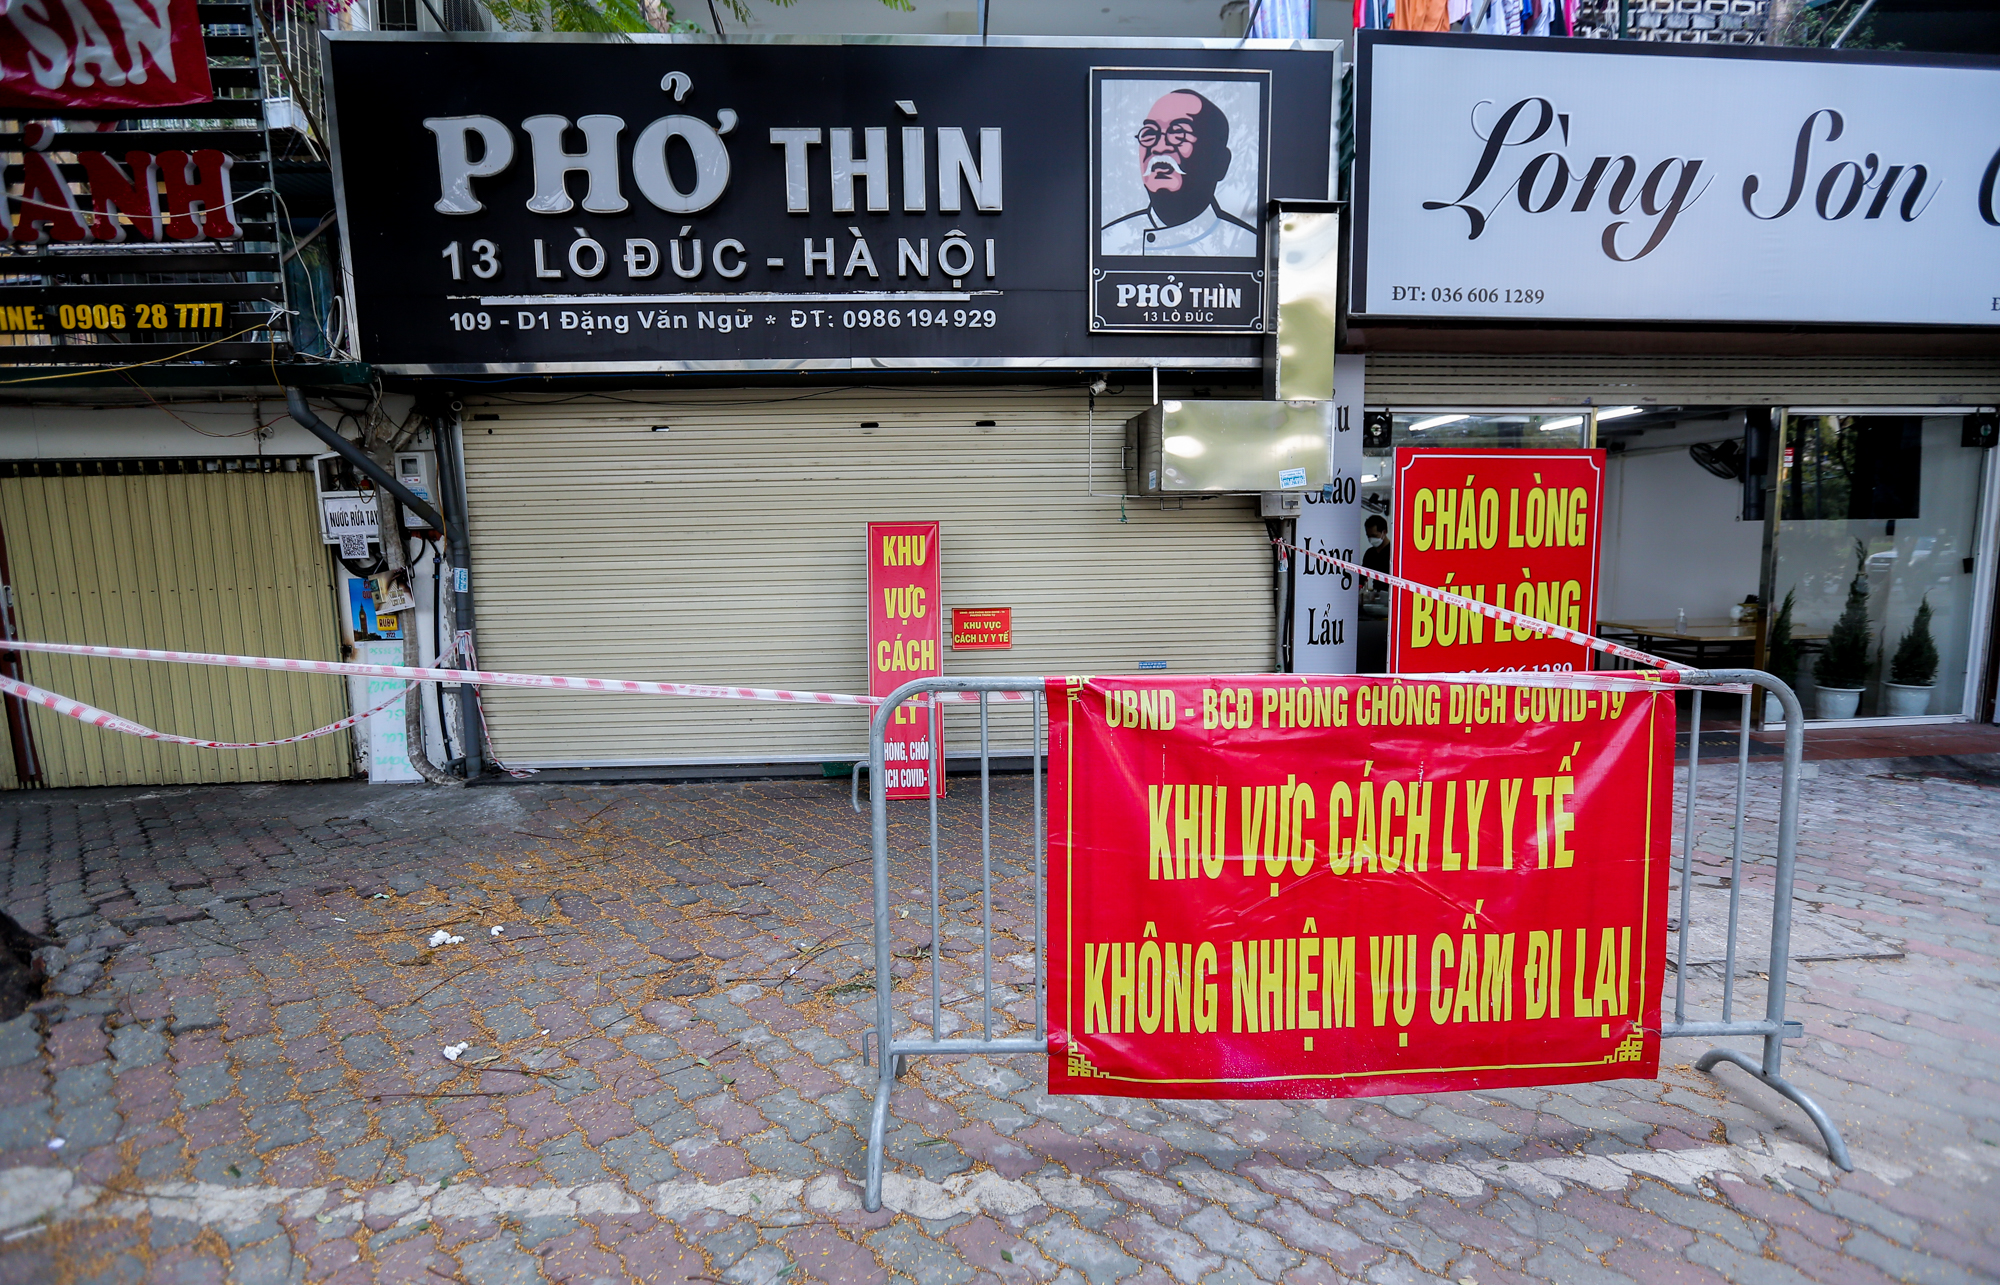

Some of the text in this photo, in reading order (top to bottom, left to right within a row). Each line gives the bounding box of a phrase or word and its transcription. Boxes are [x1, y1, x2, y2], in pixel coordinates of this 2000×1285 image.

[423, 71, 1002, 214] PHỞ THÌN
[1423, 96, 1716, 262] Lòng
[1742, 108, 1943, 222] Sơn
[442, 225, 995, 288] 13 LÒ ĐÚC - HÀ NỘI
[1116, 275, 1241, 308] PHỞ THÌN
[1392, 285, 1545, 304] ĐT: 036 606 1289
[59, 304, 127, 330] 0906
[135, 304, 168, 329] 28
[174, 303, 223, 329] 7777
[449, 312, 492, 331] 109
[517, 311, 549, 330] D1
[560, 310, 630, 335] Đặng
[637, 309, 688, 329] Văn
[698, 308, 753, 333] Ngữ
[790, 310, 834, 328] ĐT:
[843, 309, 901, 328] 0986
[906, 309, 948, 327] 194
[953, 309, 996, 328] 929
[1143, 309, 1214, 322] 13 LÒ ĐÚC
[1413, 472, 1588, 552] CHÁO LÒNG
[882, 535, 926, 566] KHU
[1303, 537, 1354, 590] Lòng
[884, 584, 926, 625] VỰC
[1307, 603, 1345, 645] Lẩu
[1411, 567, 1582, 648] BÚN LÒNG
[954, 630, 1010, 643] CÁCH LY Y TẾ
[963, 621, 1002, 631] KHU VỰC
[877, 633, 935, 672] CÁCH
[1105, 688, 1176, 731] UBND
[1185, 708, 1194, 717] -
[1202, 687, 1253, 730] BCĐ
[1262, 677, 1349, 729] PHÒNG
[1449, 684, 1507, 733] DỊCH
[1514, 685, 1626, 724] COVID-19
[884, 737, 909, 763] HÒNG,
[1148, 742, 1581, 897] KHU VỰC CÁCH LY Y TẾ
[1084, 899, 1631, 1051] KHÔNG NHIỆM VỤ CẤM ĐI LẠI
